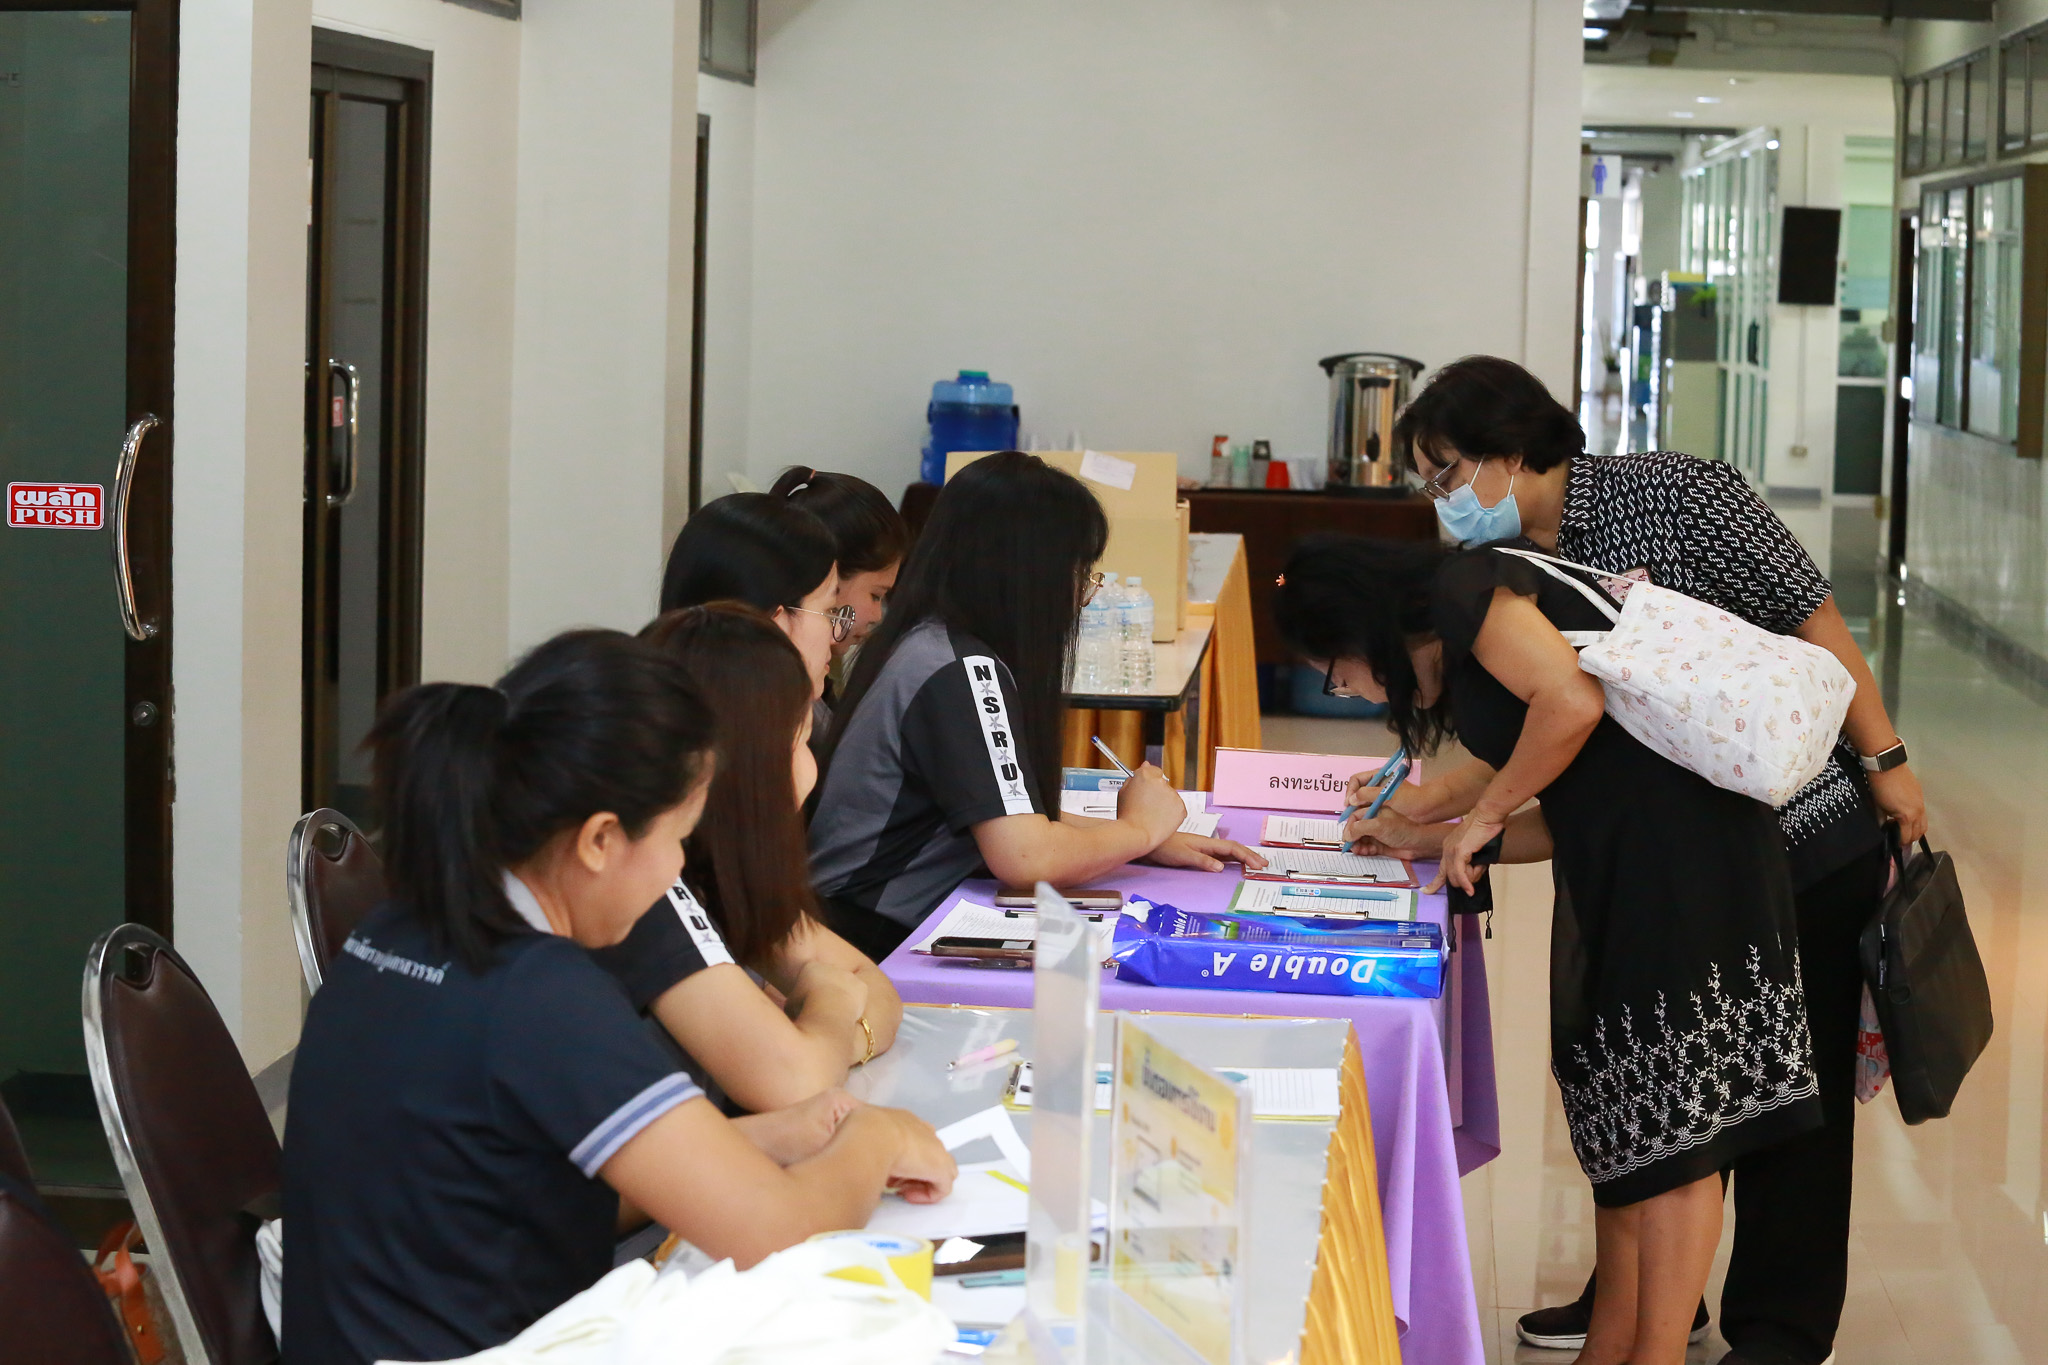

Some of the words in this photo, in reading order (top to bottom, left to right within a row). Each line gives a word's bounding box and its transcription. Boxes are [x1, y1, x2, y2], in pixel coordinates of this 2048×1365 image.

[15, 487, 96, 507] ผลัก
[14, 508, 96, 525] PUSH
[1269, 773, 1350, 793] ลงทะเบีย
[1249, 953, 1377, 984] Double
